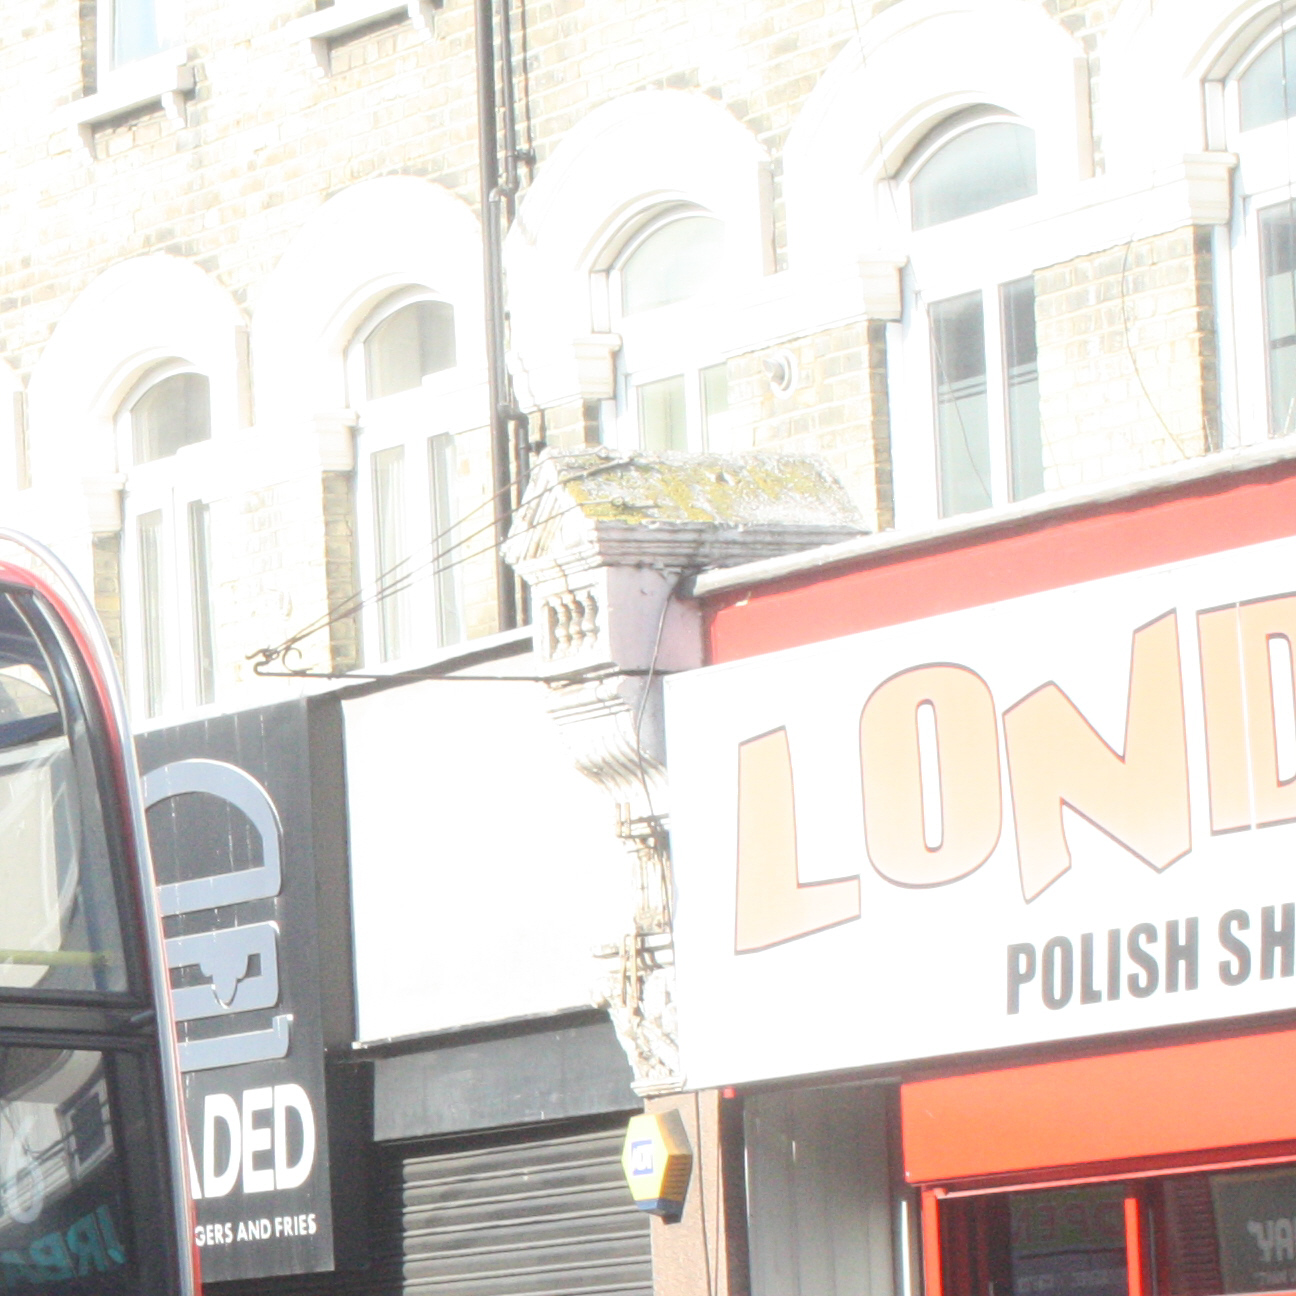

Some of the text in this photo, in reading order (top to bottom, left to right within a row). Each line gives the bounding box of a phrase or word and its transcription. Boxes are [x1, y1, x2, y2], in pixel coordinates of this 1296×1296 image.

[1007, 902, 1296, 1015] POLISH SH
[237, 1217, 272, 1241] AND
[274, 1213, 317, 1238] FRIES
